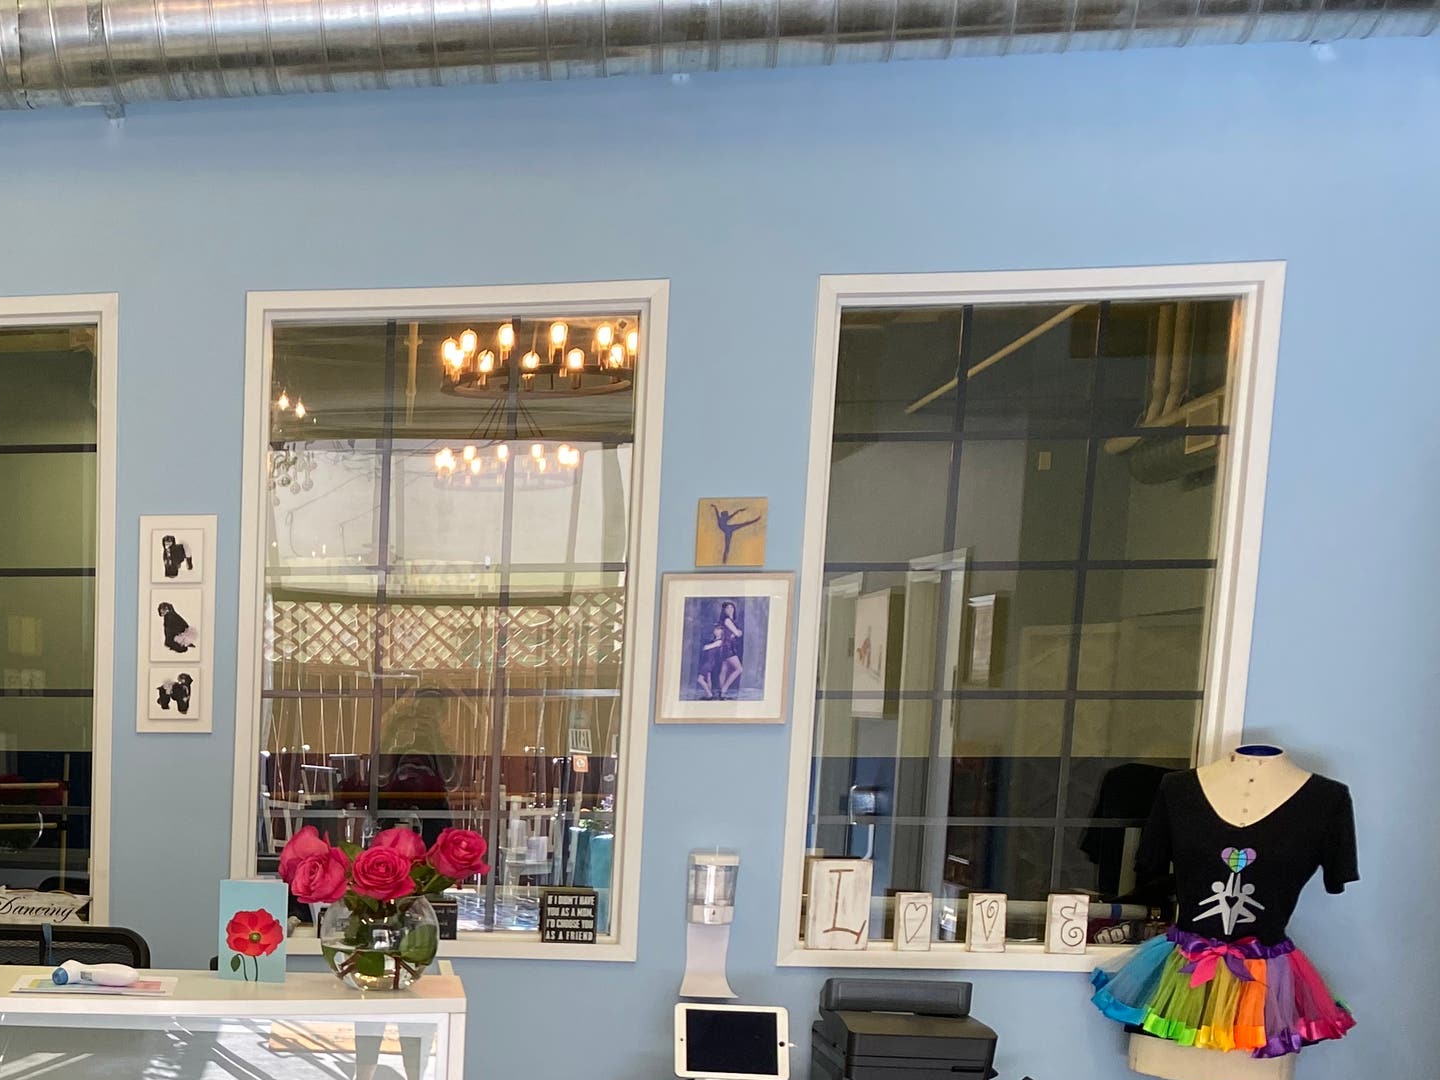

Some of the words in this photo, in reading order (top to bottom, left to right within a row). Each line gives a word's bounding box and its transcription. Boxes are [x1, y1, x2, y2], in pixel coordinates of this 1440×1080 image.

[558, 895, 578, 904] DIDN'T
[579, 896, 595, 905] HAVE
[548, 907, 559, 916] YOU
[561, 907, 569, 916] AS
[571, 908, 575, 916] A
[556, 919, 580, 929] CHOOSE
[581, 920, 594, 929] YOU
[545, 930, 555, 939] AS
[558, 930, 564, 940] A
[566, 930, 593, 941] FRIEND
